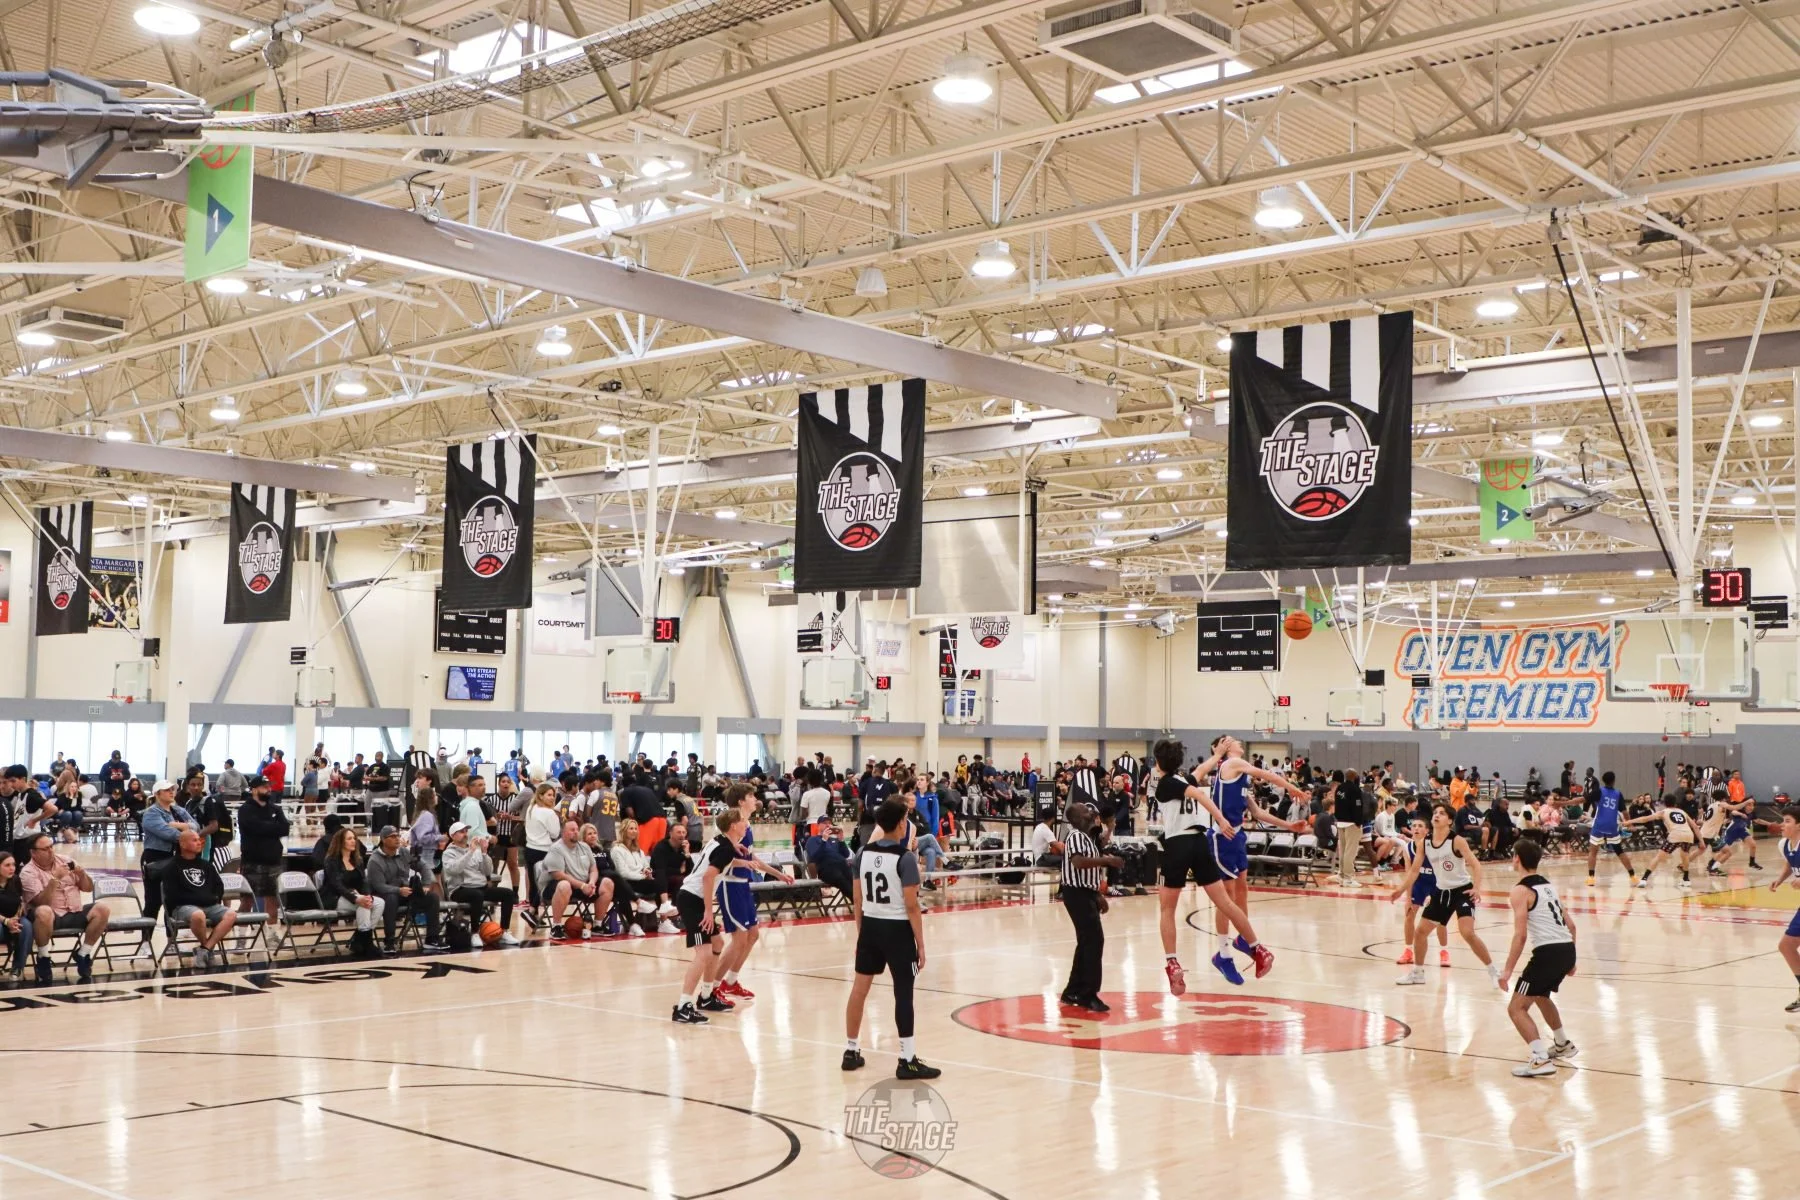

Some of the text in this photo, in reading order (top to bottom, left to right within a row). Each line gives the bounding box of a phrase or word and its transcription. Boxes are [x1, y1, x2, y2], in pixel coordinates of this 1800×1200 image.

[212, 208, 219, 233] 1
[1263, 438, 1307, 471] THE
[1297, 449, 1376, 487] STAGE
[820, 481, 852, 509] THE
[845, 492, 899, 522] STAGE
[1501, 509, 1509, 521] 2
[461, 520, 484, 543] THE
[478, 529, 517, 554] STAGE
[240, 543, 258, 563] THE
[253, 551, 281, 573] STAGE
[48, 564, 60, 584] THE
[105, 560, 143, 568] MARGARIA
[1710, 572, 1742, 601] 30
[538, 619, 585, 629] COURTSMIT
[656, 620, 672, 640] 30
[982, 622, 1009, 636] STAGE
[1256, 629, 1272, 637] GUEST
[1519, 629, 1623, 670] GYM
[878, 677, 888, 689] 30
[601, 798, 617, 816] 33
[1603, 796, 1617, 810] 35
[1672, 813, 1685, 822] 15
[864, 871, 891, 904] 12
[0, 961, 498, 1013] KeyBan
